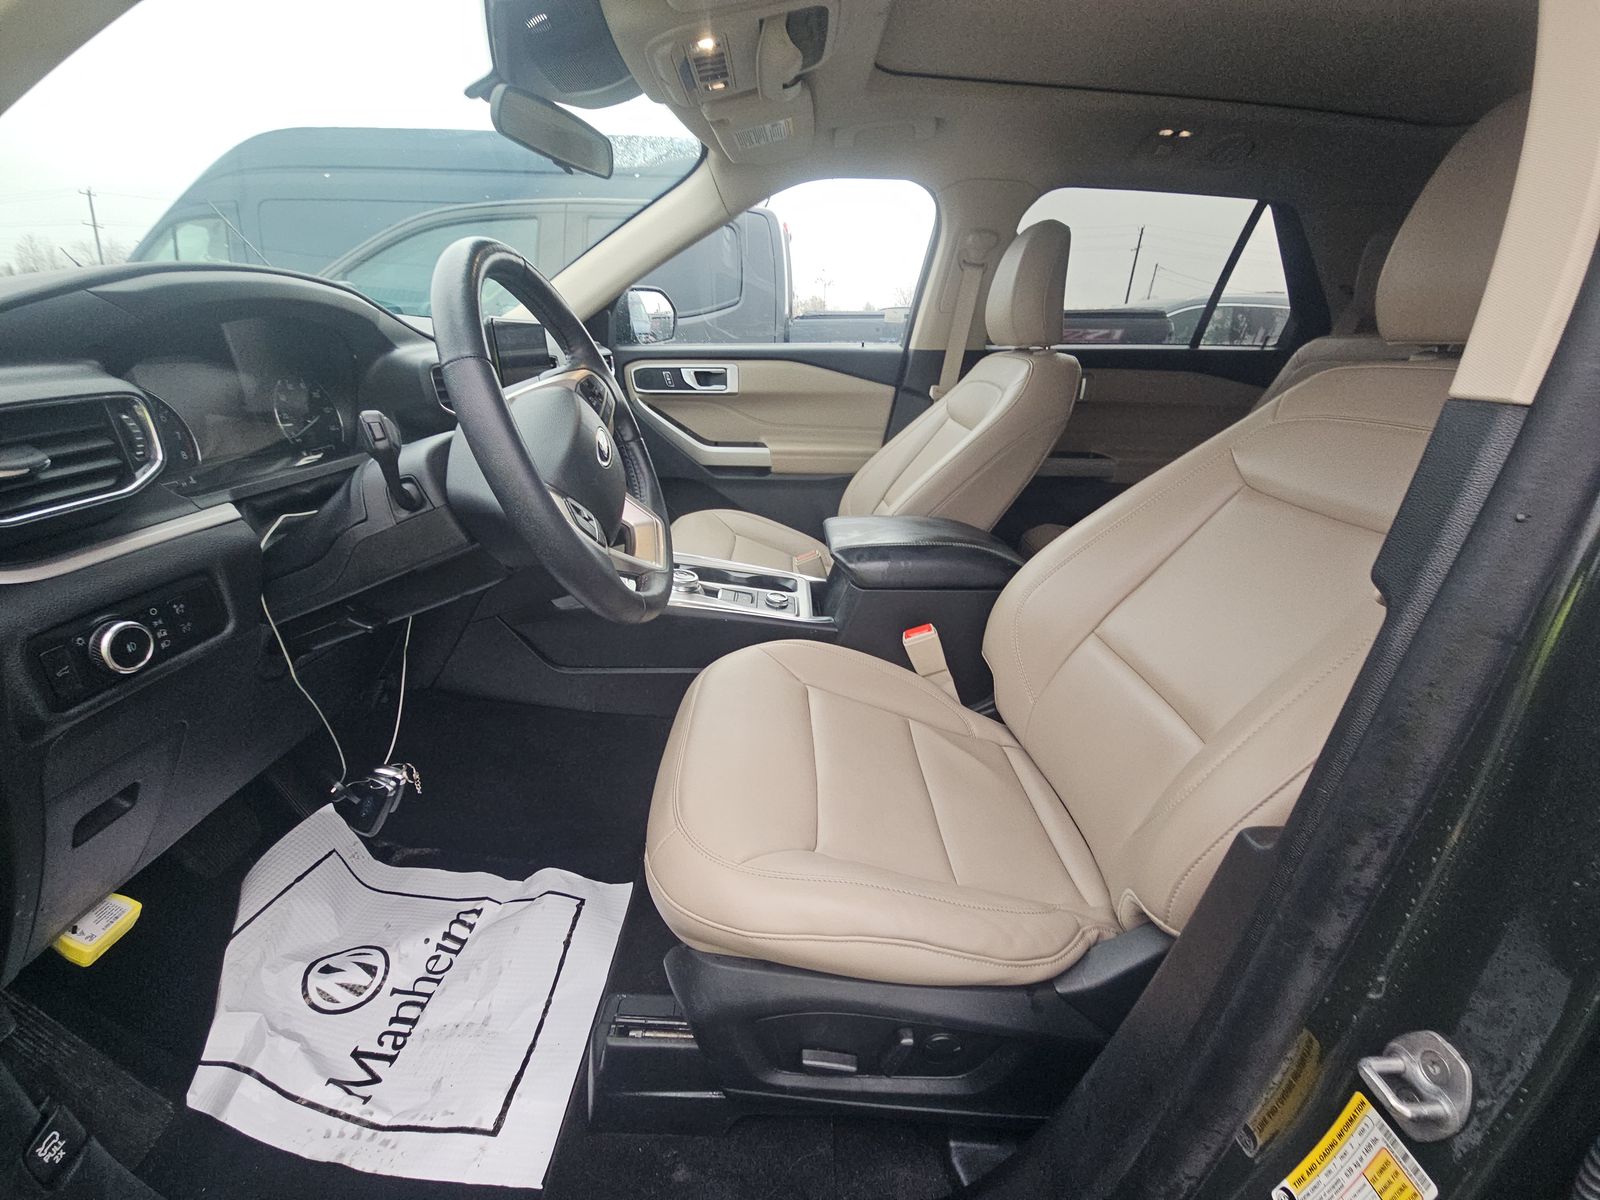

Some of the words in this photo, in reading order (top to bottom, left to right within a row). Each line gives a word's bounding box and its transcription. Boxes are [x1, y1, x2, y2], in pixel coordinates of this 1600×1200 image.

[324, 907, 484, 1105] Manheim
[43, 1140, 66, 1163] PULL
[53, 1149, 66, 1164] 2X
[1293, 1174, 1307, 1189] TIRE
[1305, 1162, 1318, 1177] AND
[1315, 1138, 1338, 1166] LOADING
[1335, 1098, 1367, 1142] INFORMATION
